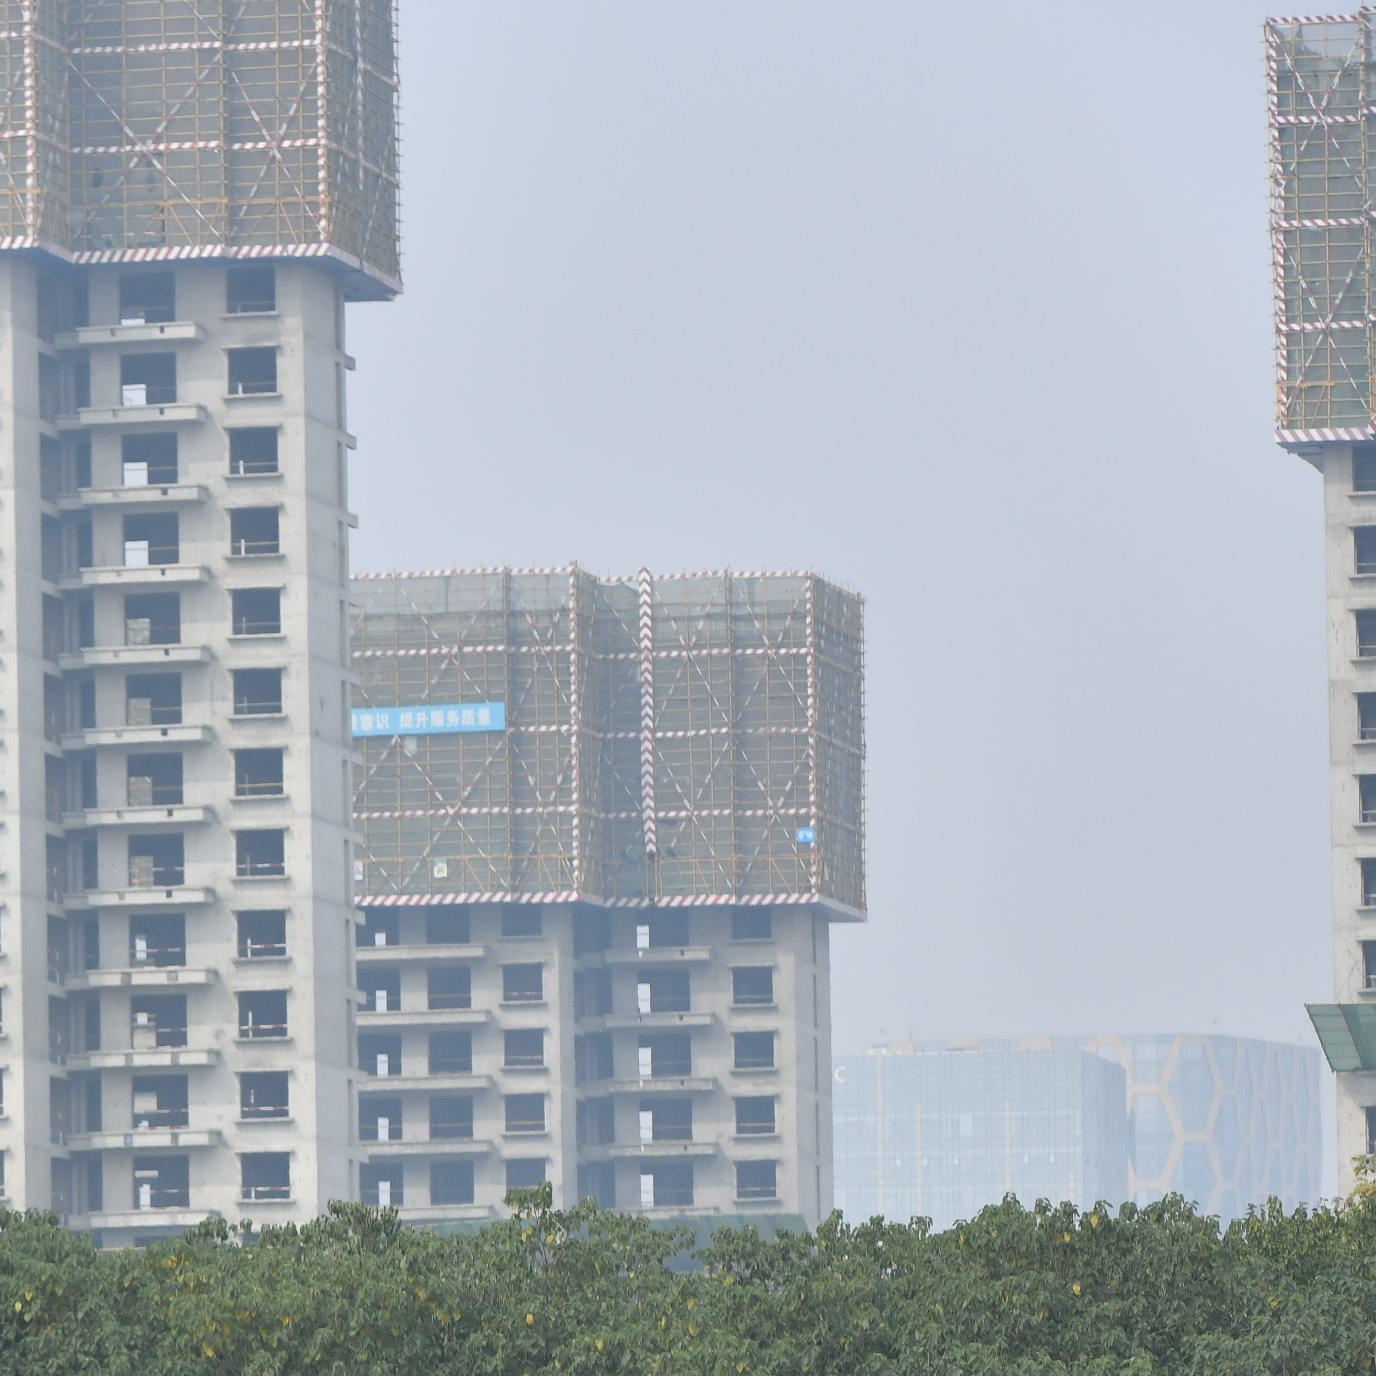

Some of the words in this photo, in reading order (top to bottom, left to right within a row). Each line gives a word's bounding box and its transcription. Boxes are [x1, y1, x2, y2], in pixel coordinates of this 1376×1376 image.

[400, 708, 491, 729] 提升服务质量
